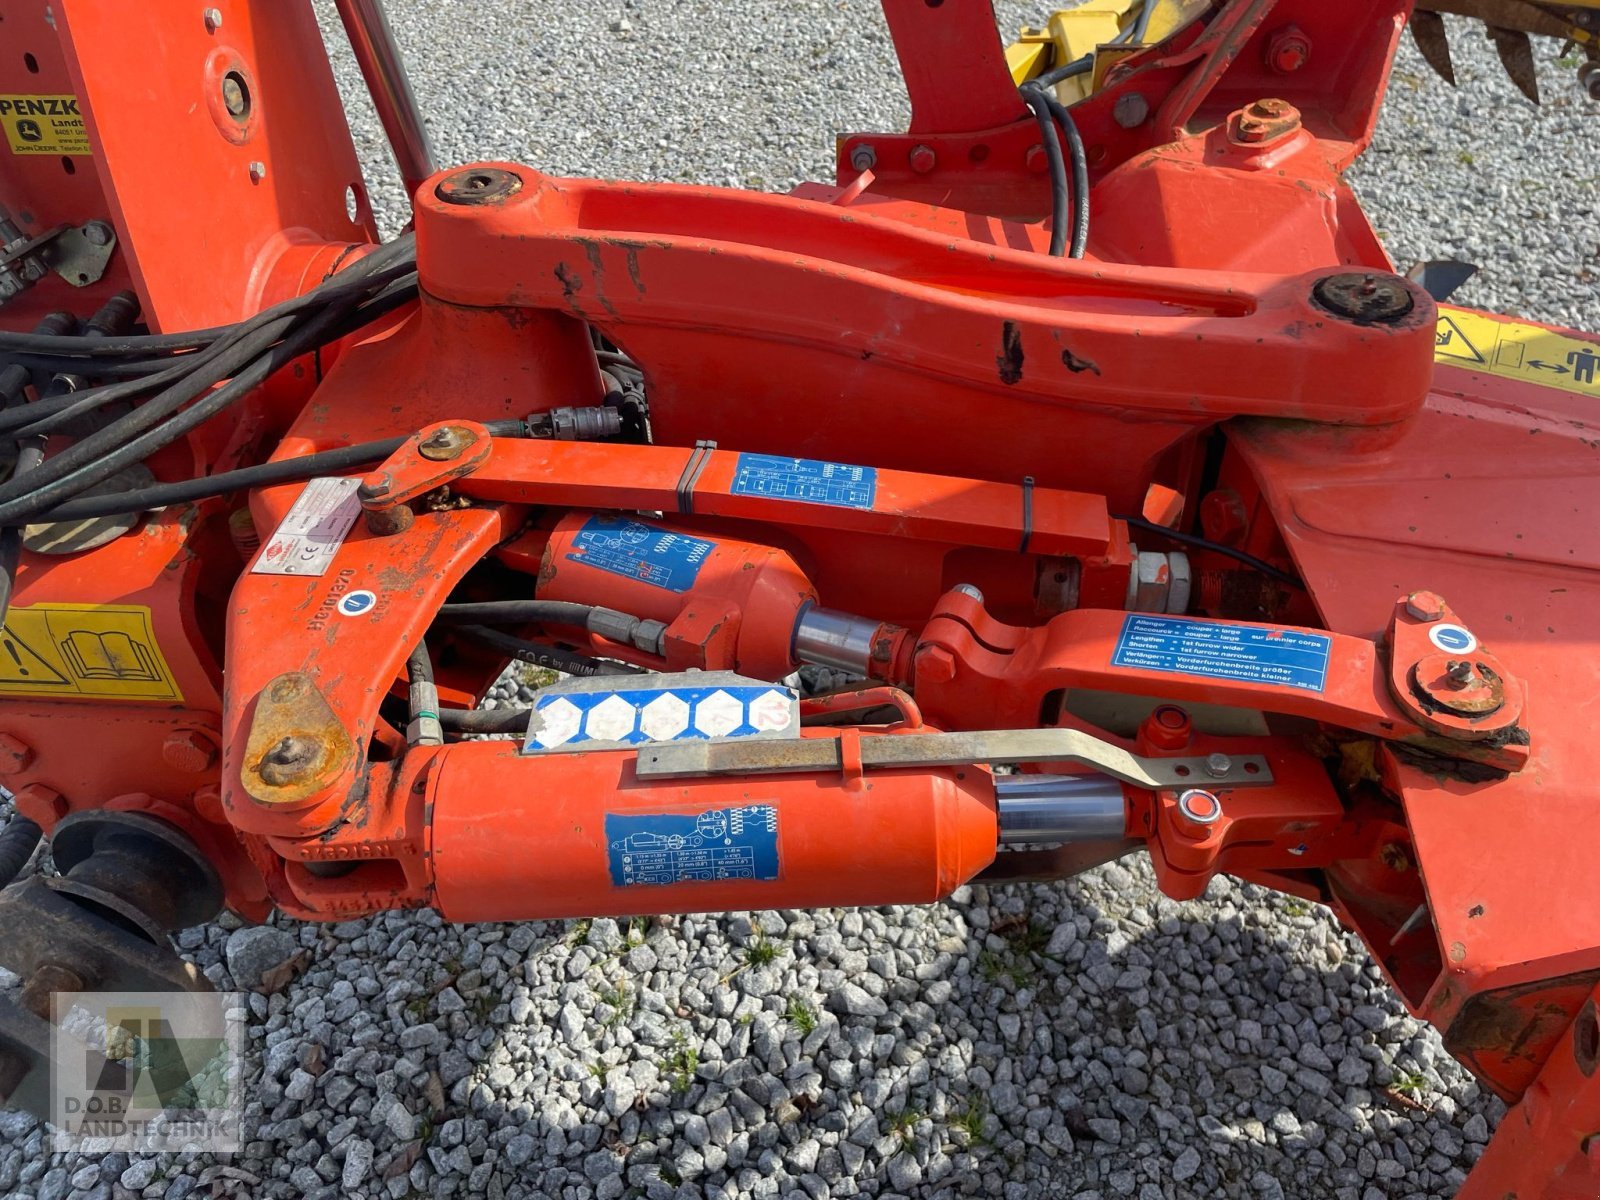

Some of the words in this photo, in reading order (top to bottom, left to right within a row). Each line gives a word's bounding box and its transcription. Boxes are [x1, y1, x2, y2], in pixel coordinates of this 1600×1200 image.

[1079, 197, 1089, 240] HANSA-FLEX
[1131, 634, 1165, 643] Lengthen
[1126, 650, 1165, 659] Verlängern
[1177, 656, 1261, 671] Vorderfurchenbreite
[1193, 648, 1222, 656] furrow
[1221, 652, 1257, 660] narrower
[1123, 657, 1160, 666] Verkürzen
[1175, 663, 1259, 679] Vorderfurchenbreite
[1261, 673, 1292, 682] kleiner
